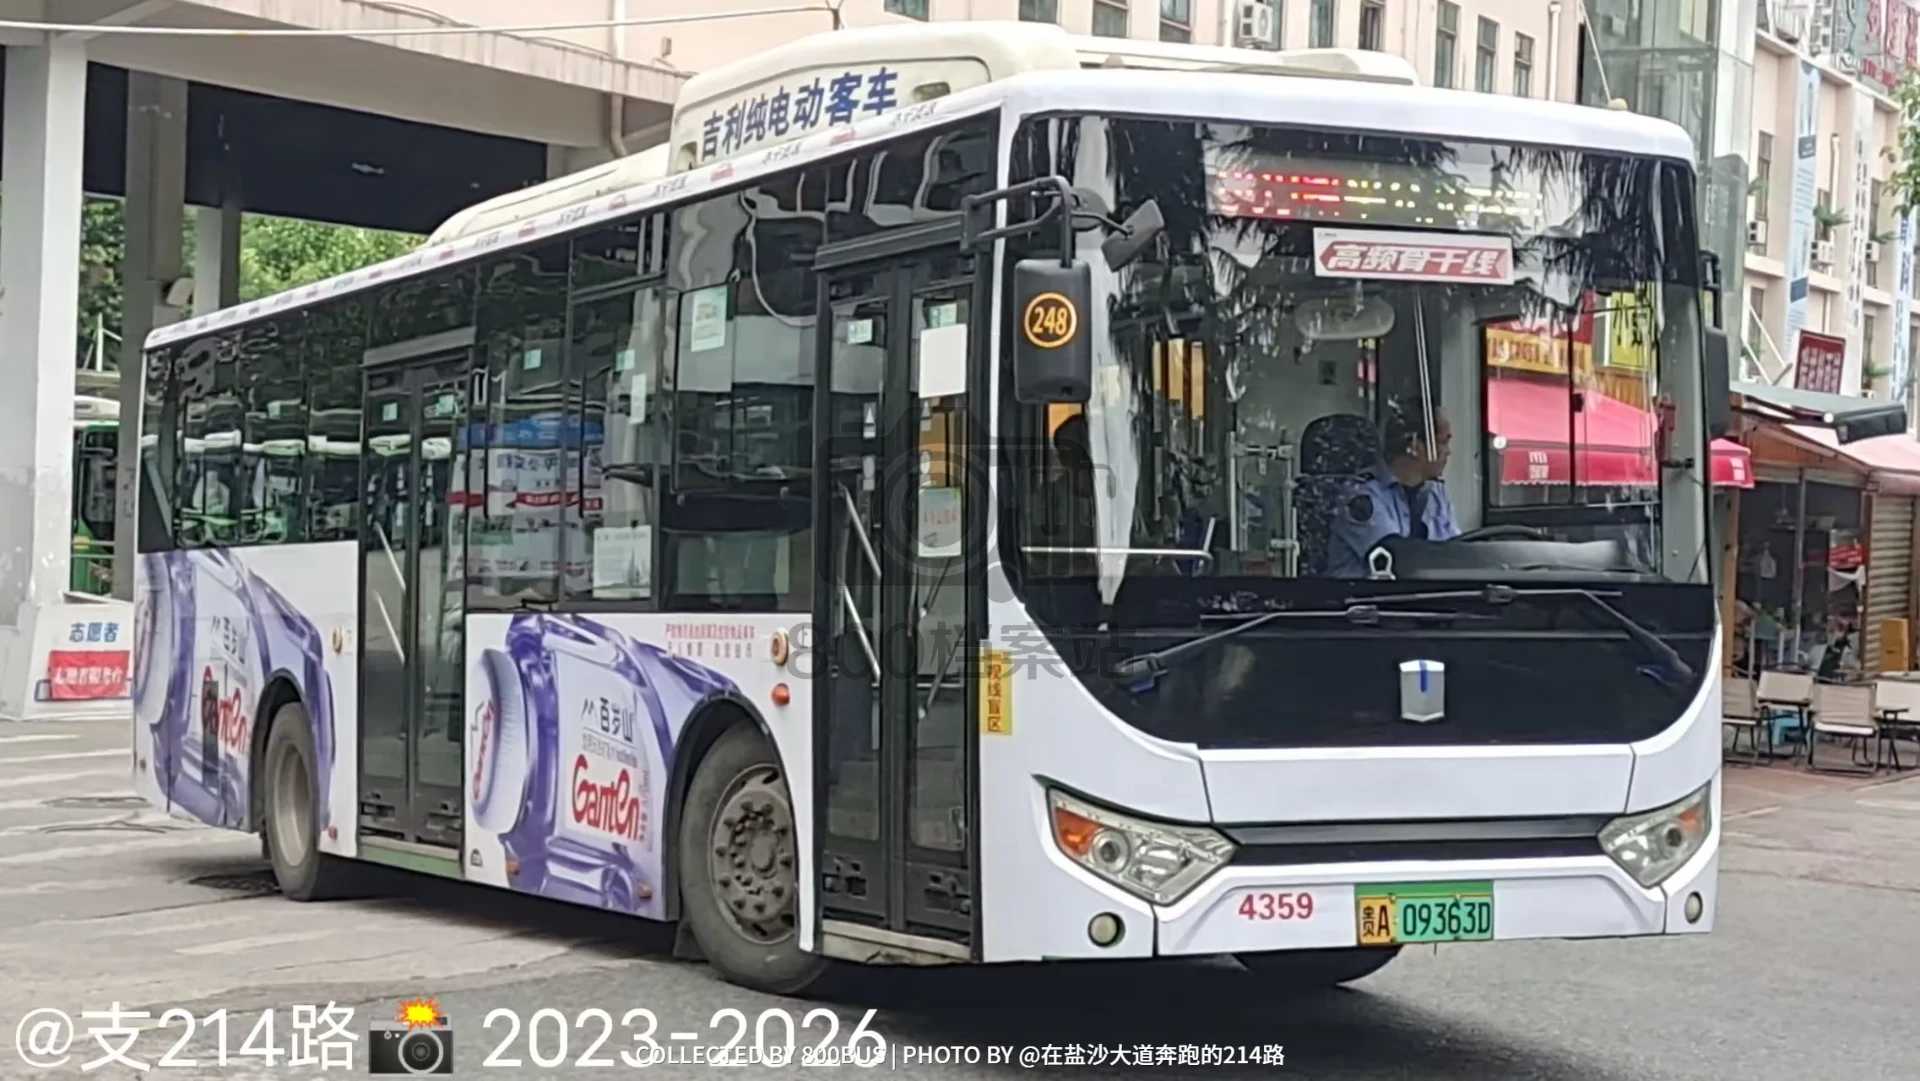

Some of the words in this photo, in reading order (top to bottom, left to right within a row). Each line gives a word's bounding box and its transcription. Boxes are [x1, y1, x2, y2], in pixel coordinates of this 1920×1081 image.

[702, 67, 898, 161] 吉利纯电动客车
[1327, 243, 1499, 276] 高频骨干线
[1032, 306, 1068, 336] 248
[69, 622, 119, 642] 志愿者
[572, 753, 640, 841] Ganten
[1238, 892, 1313, 920] 4359
[1403, 901, 1491, 937] 09363D
